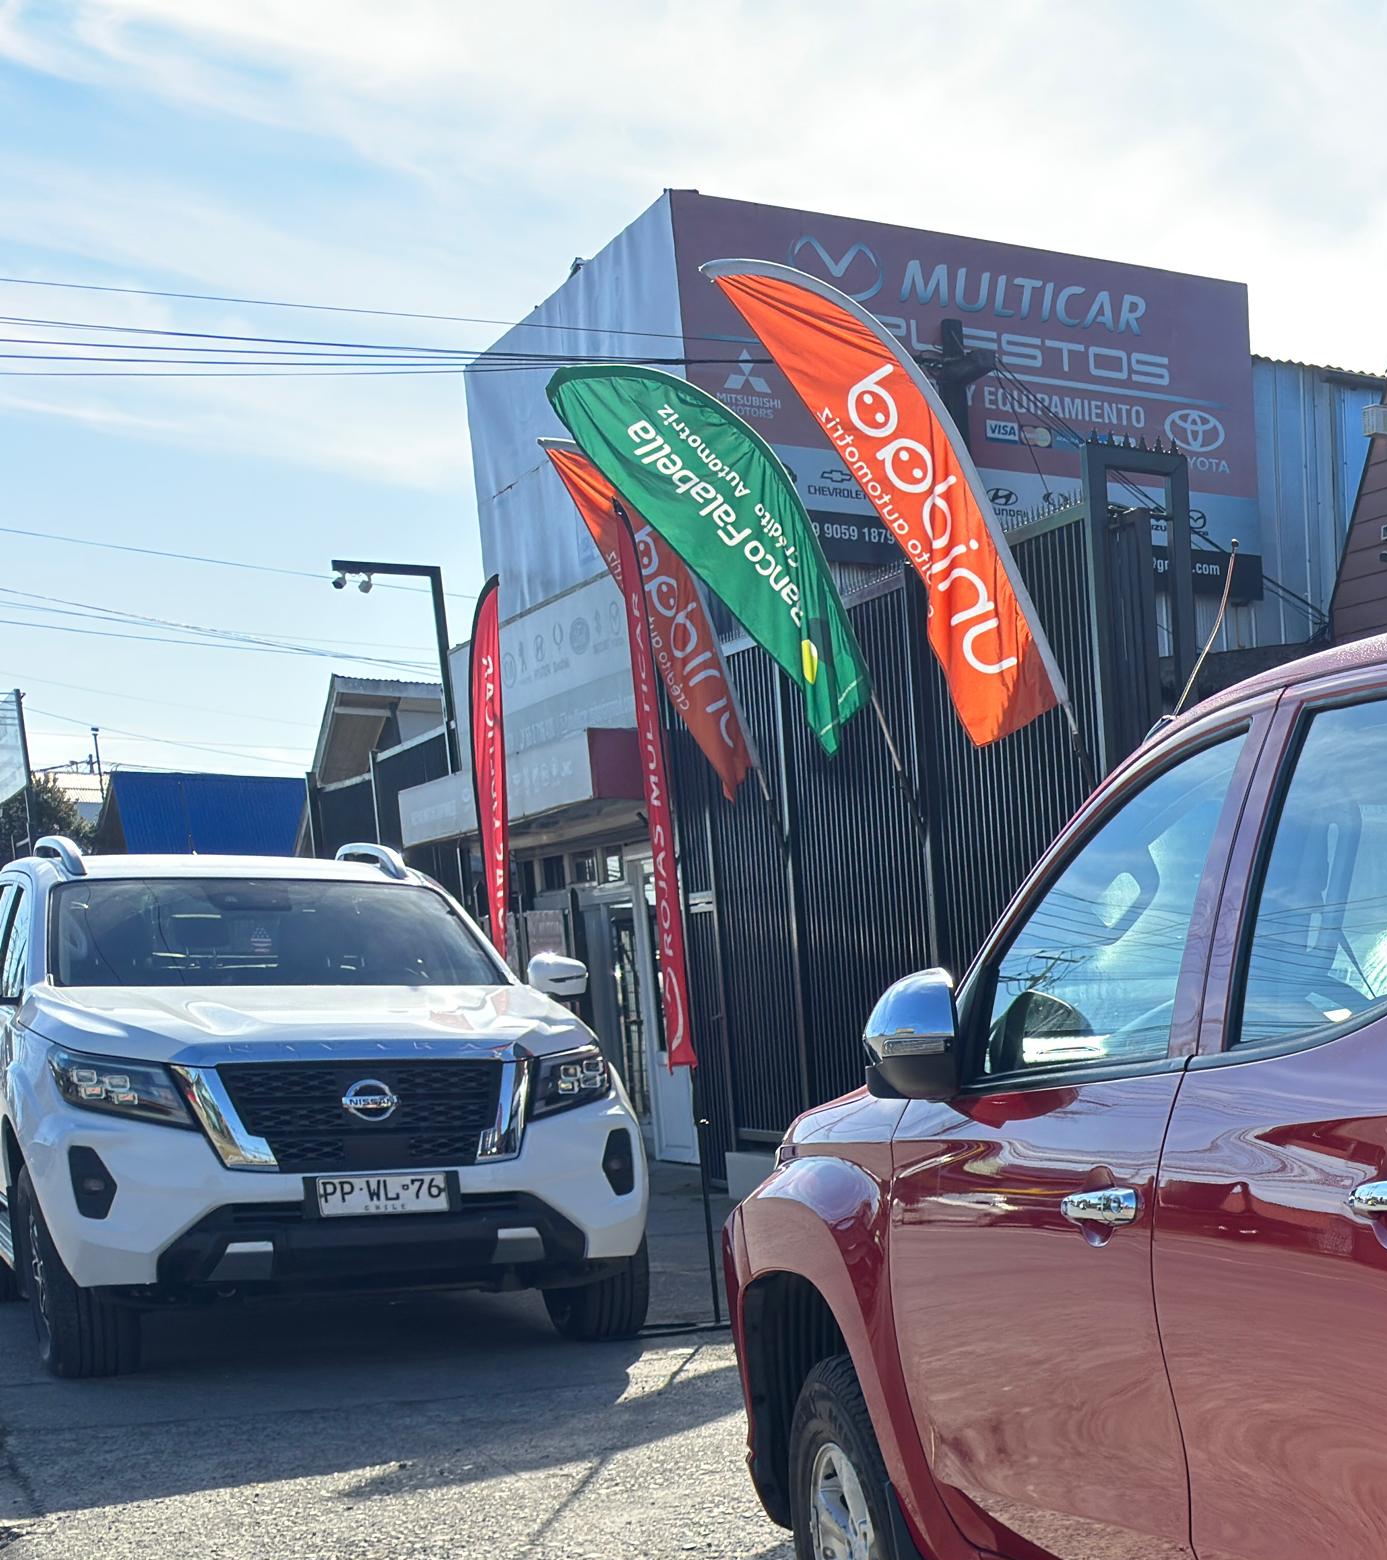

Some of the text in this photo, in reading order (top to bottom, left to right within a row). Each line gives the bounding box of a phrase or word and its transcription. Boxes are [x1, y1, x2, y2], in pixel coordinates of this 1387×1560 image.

[901, 259, 1147, 337] MULTICAR
[874, 314, 1170, 386] PUESTOS
[984, 385, 1146, 428] EQUIPAMIENTO
[988, 423, 1017, 437] VISA
[627, 420, 752, 547] Falabella
[657, 404, 752, 498] Automotriz
[1185, 457, 1230, 474] YOTA
[824, 523, 858, 540] 9059
[654, 823, 673, 949] ROJAS
